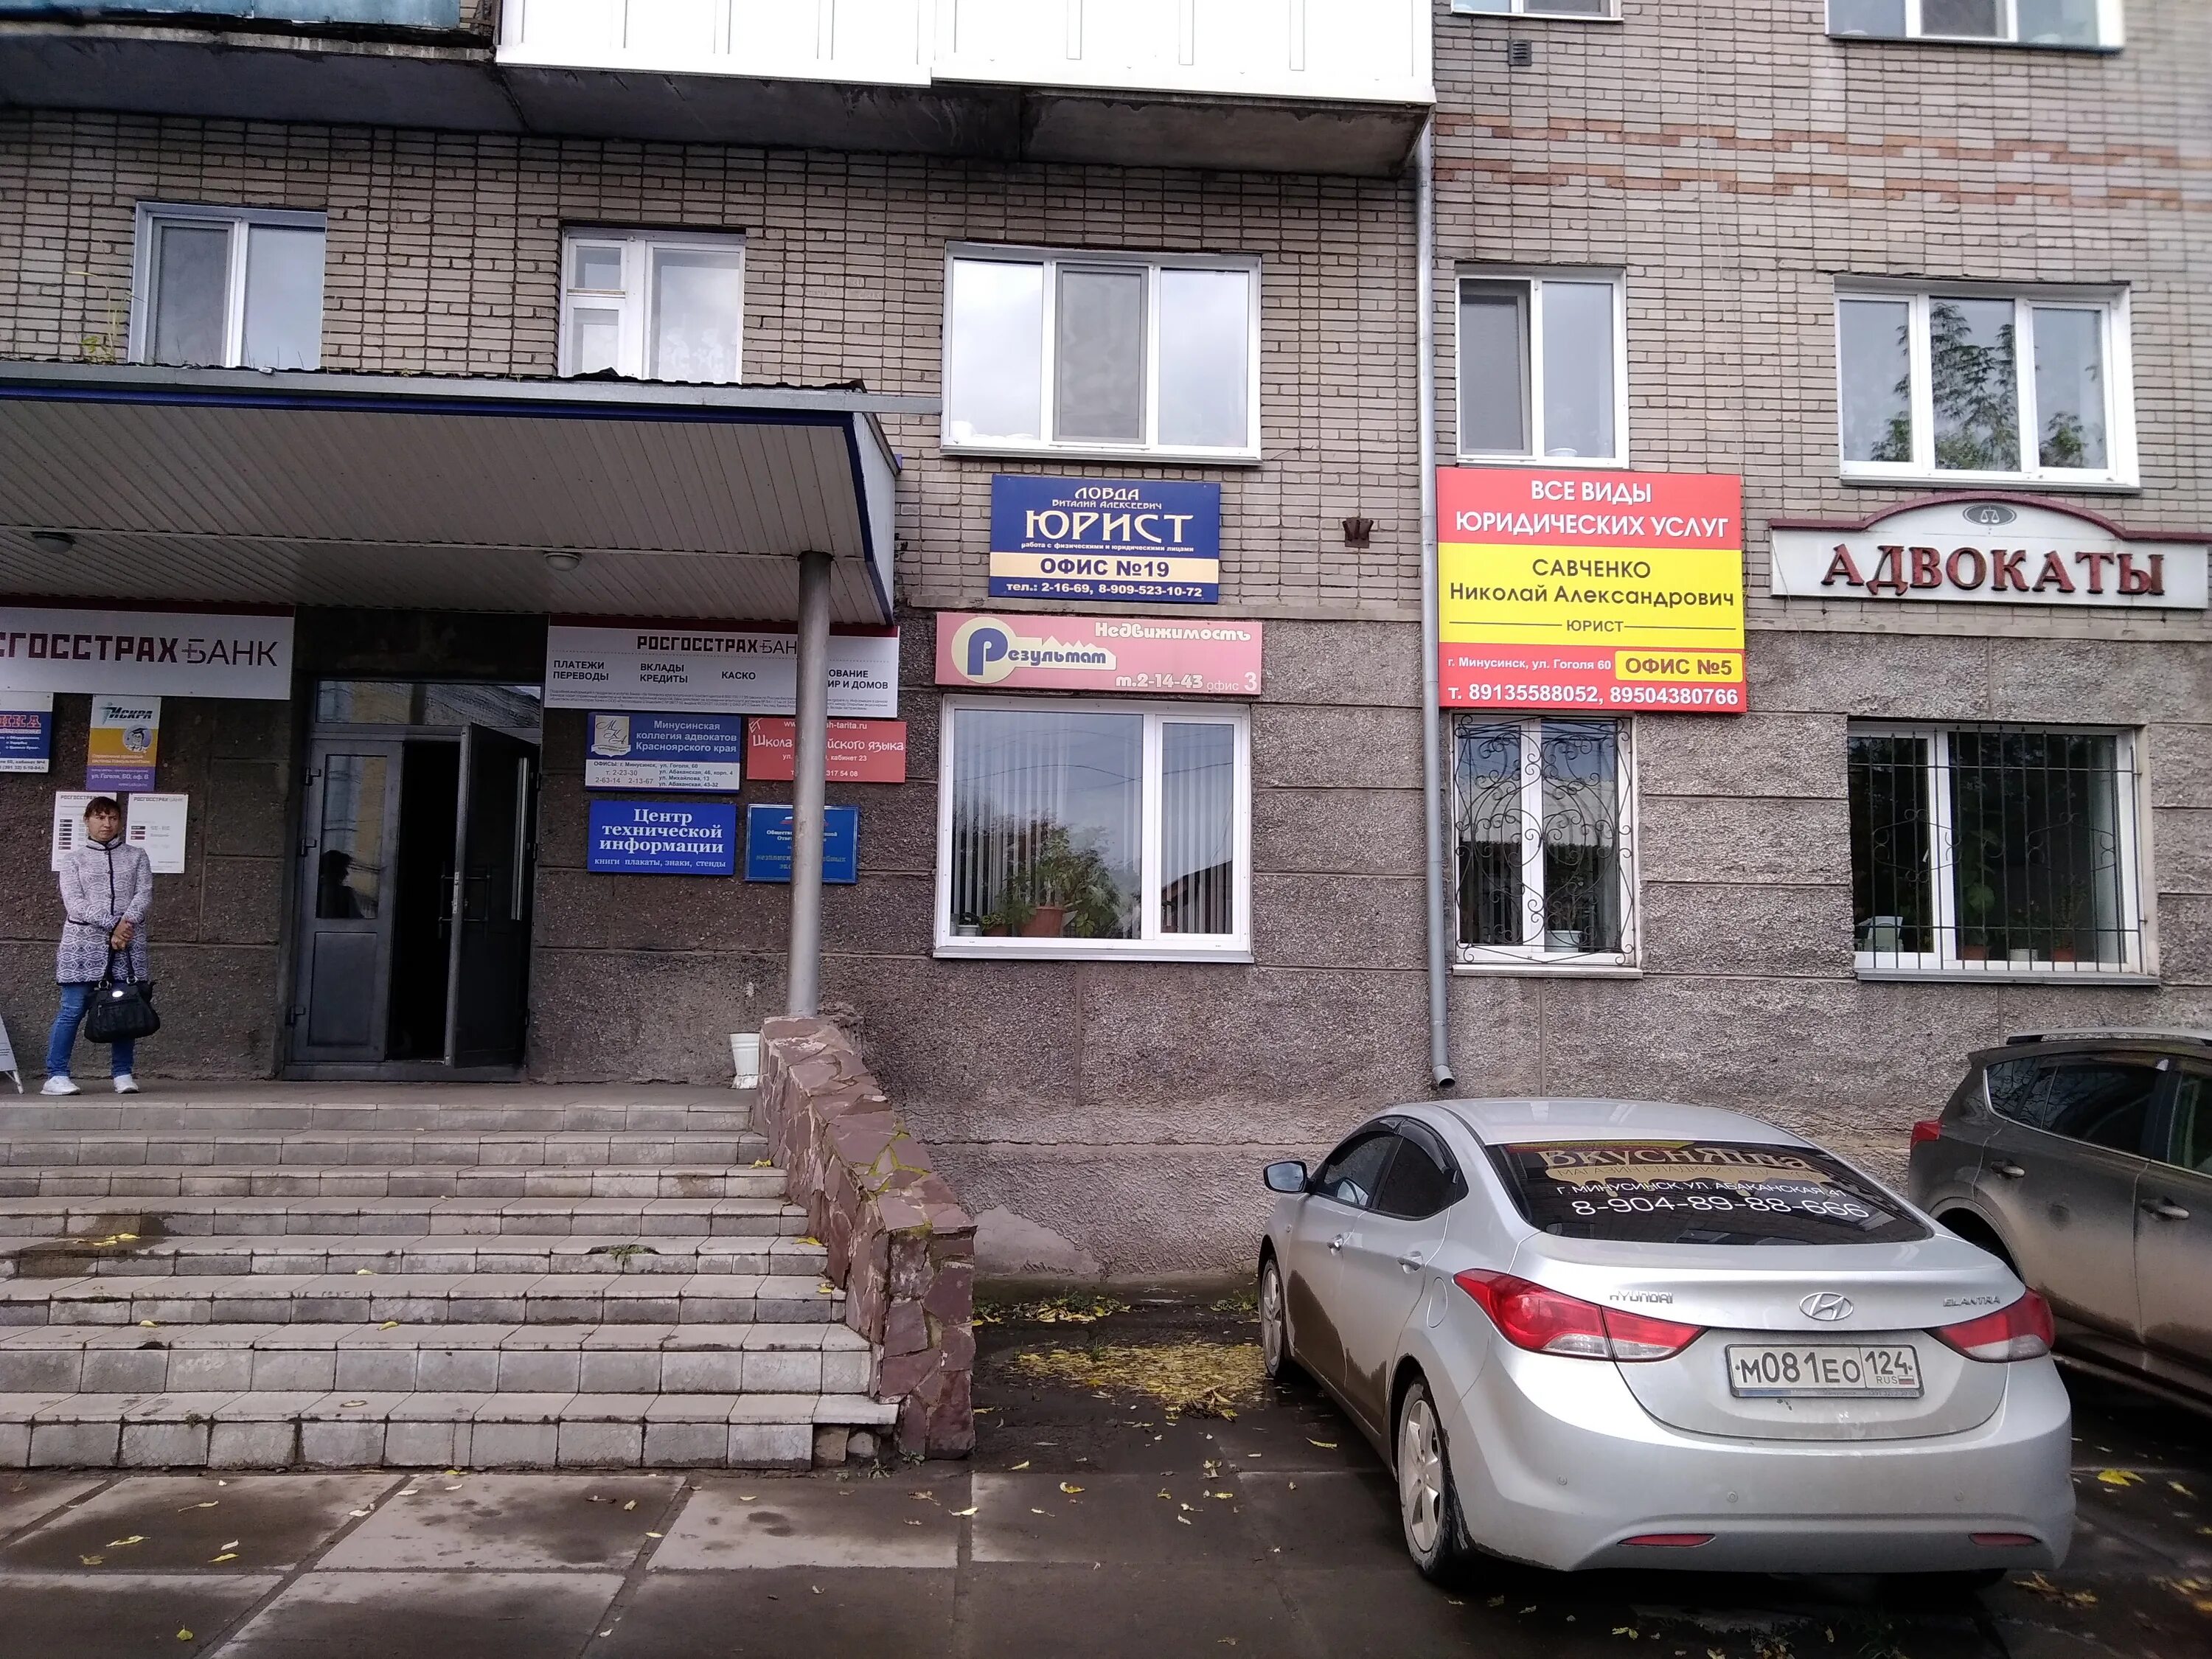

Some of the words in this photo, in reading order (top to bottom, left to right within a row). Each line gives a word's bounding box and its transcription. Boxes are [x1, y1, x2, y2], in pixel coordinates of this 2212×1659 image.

[1074, 487, 1139, 501] ЛОВДА
[1531, 480, 1575, 501] ВСЕ
[1582, 481, 1652, 504] ВИДЫ
[1026, 509, 1194, 544] ЮРИСТ
[1455, 511, 1645, 536] ЮРИДИЧЕСКИХ
[1650, 517, 1729, 538] УСЛУГ
[1040, 557, 1108, 575] ОФИС
[1116, 560, 1169, 577] №19
[1532, 558, 1651, 579] САВЧЕНКО
[1820, 543, 2165, 597] АДВОКАТЫ
[1006, 582, 1037, 591] тел.:
[1041, 582, 1093, 596] 2-16-69,
[1099, 583, 1203, 597] 8-909-523-10-72
[1450, 582, 1548, 602] Николай
[1554, 584, 1734, 608] Александрович
[1095, 622, 1251, 641] Недвижимость
[1566, 619, 1624, 633] ЮРИСТ
[0, 632, 179, 663] ГОССТРАХ
[182, 638, 278, 667] БАНК
[637, 636, 758, 653] РОСГОССТРАХ
[759, 639, 797, 655] БАН
[967, 627, 1107, 676] Результат
[553, 660, 605, 669] ПЛАТЕЖИ
[640, 663, 685, 673] ВКЛАДЫ
[1447, 658, 1455, 667] г.
[1458, 657, 1528, 671] Минусинск,
[1532, 660, 1549, 670] ул.
[1553, 658, 1594, 670] Гоголя
[1597, 660, 1611, 669] 60
[1625, 656, 1690, 675] ОФИС
[1697, 659, 1732, 675] №5
[552, 671, 609, 681] ПЕРЕВОДЫ
[639, 674, 688, 684] КРЕДИТЫ
[721, 671, 756, 680] КАСКО
[828, 669, 869, 678] ОВАНИЕ
[843, 680, 849, 688] И
[851, 681, 888, 689] ДОМОВ
[1206, 679, 1239, 694] офис
[1244, 672, 1257, 692] 3
[1447, 687, 1463, 700] т.
[1469, 684, 1604, 705] 89135588052,
[1610, 686, 1738, 705] 89504380766
[654, 720, 720, 730] Минусинская
[636, 732, 682, 741] коллегия
[684, 733, 737, 742] адвокатов
[752, 734, 793, 748] Школа
[826, 738, 866, 750] йского
[868, 741, 905, 753] языка
[636, 742, 711, 752] Красноярского
[714, 745, 737, 754] края
[633, 808, 692, 827] Центр
[602, 824, 723, 838] технической
[599, 838, 724, 855] информации
[625, 859, 663, 867] плакаты,
[695, 860, 726, 868] стенды
[1557, 1165, 1641, 1177] МАГАЗИН
[1571, 1182, 1684, 1193] МИНУСИНСК,
[1686, 1182, 1712, 1190] УЛ.
[1716, 1183, 1826, 1195] АБАКАНСКАЯ
[1829, 1189, 1847, 1197] 41
[1572, 1196, 1869, 1217] 8-904-89-88-666
[1942, 1295, 2000, 1307] ELANTRA
[1865, 1351, 1908, 1375] 124
[1876, 1376, 1898, 1384] RUS
